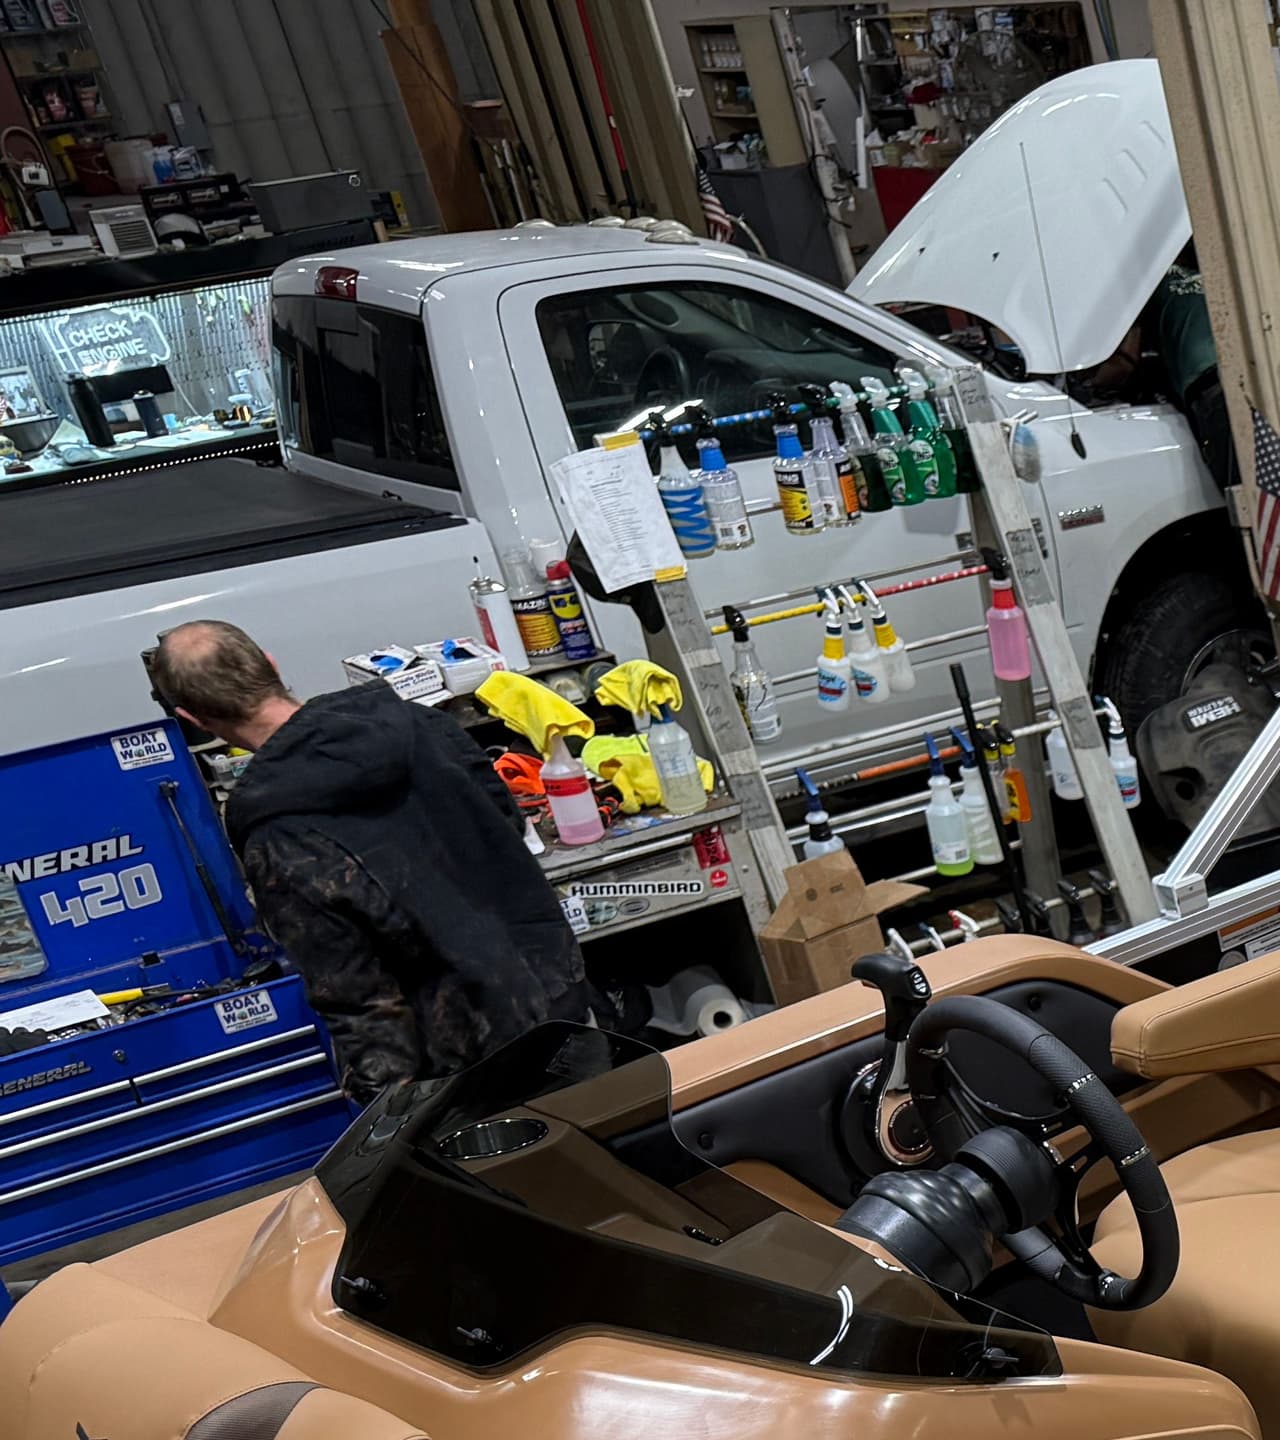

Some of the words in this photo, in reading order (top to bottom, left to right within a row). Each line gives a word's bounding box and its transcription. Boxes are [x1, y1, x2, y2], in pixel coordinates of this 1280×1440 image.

[68, 320, 132, 347] CHECK
[77, 338, 148, 366] ENGINE
[119, 731, 157, 748] BOAT
[0, 835, 143, 882] NERAL
[40, 863, 163, 928] 420
[571, 882, 702, 897] HUMMINBIRD
[222, 993, 260, 1013] BOAT
[0, 1061, 91, 1097] ENERAL
